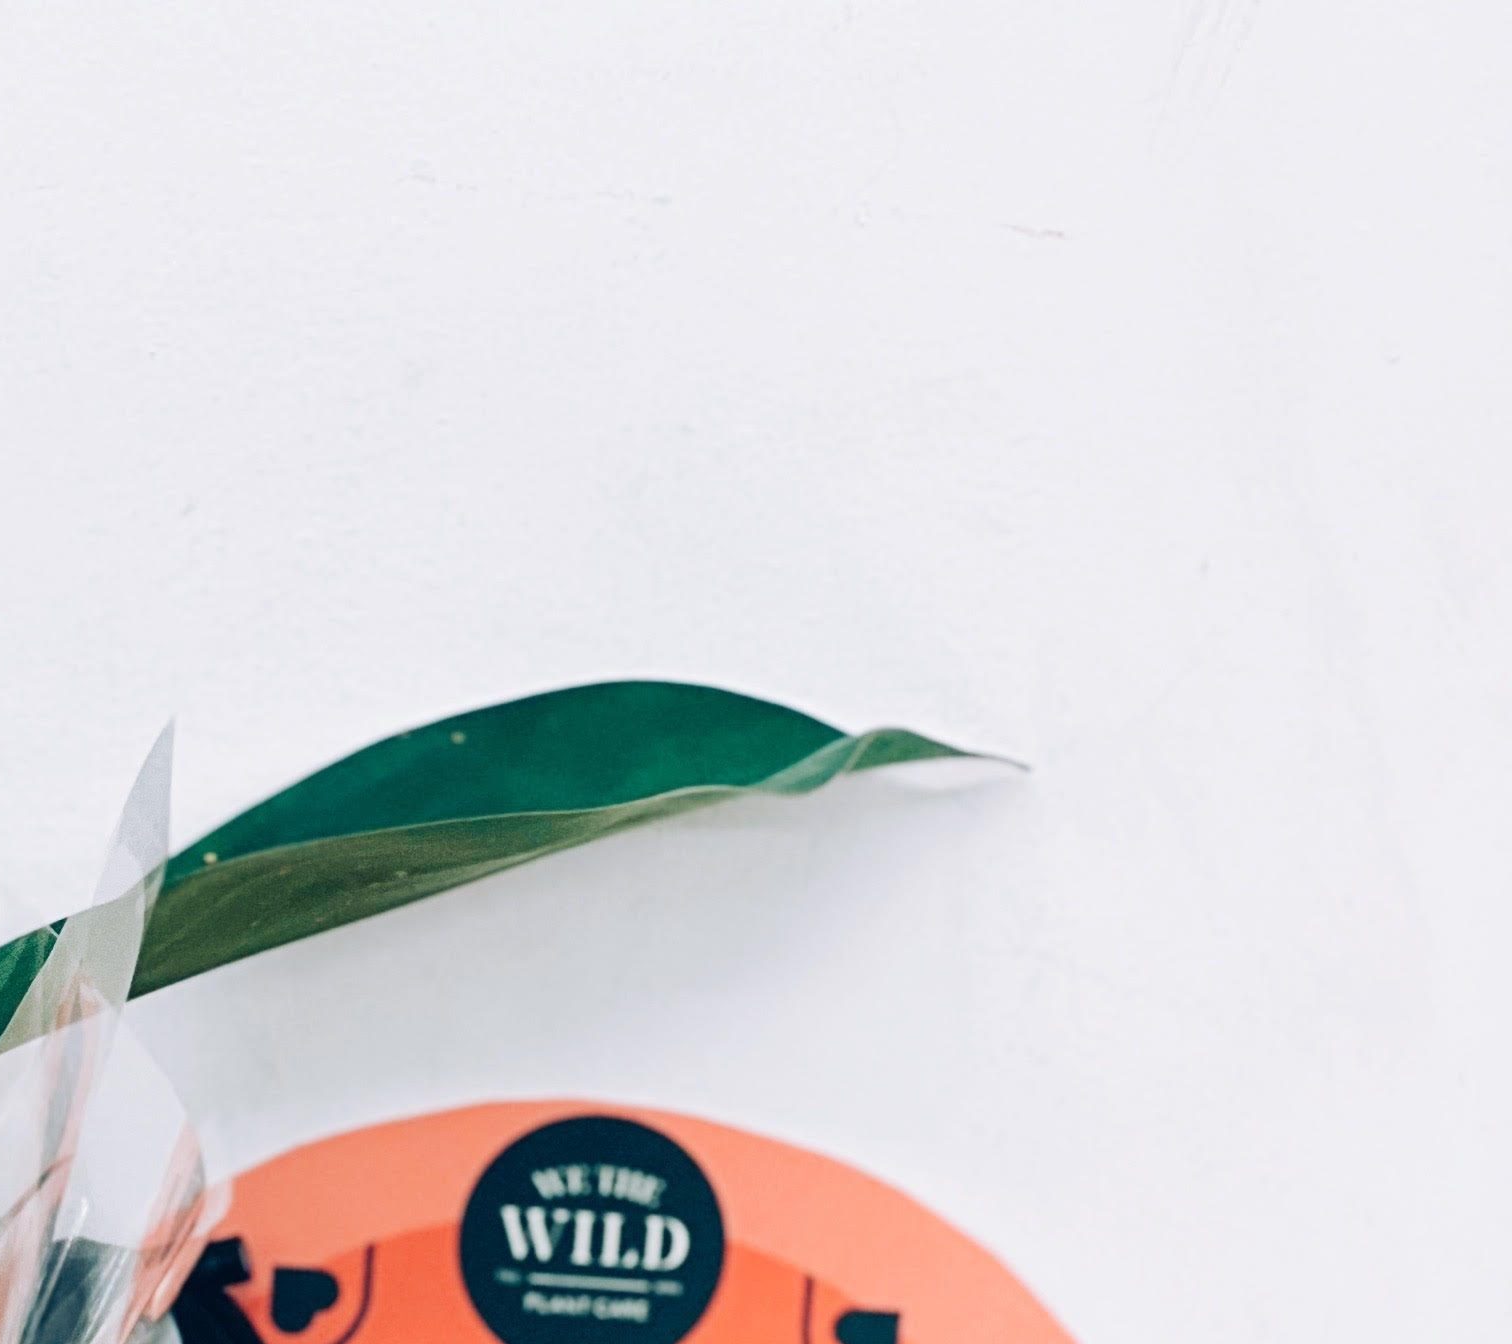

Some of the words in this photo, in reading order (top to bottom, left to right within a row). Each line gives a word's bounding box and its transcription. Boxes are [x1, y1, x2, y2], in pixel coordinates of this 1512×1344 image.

[531, 1163, 593, 1200] WE
[596, 1163, 669, 1210] THE
[500, 1204, 691, 1272] WILD
